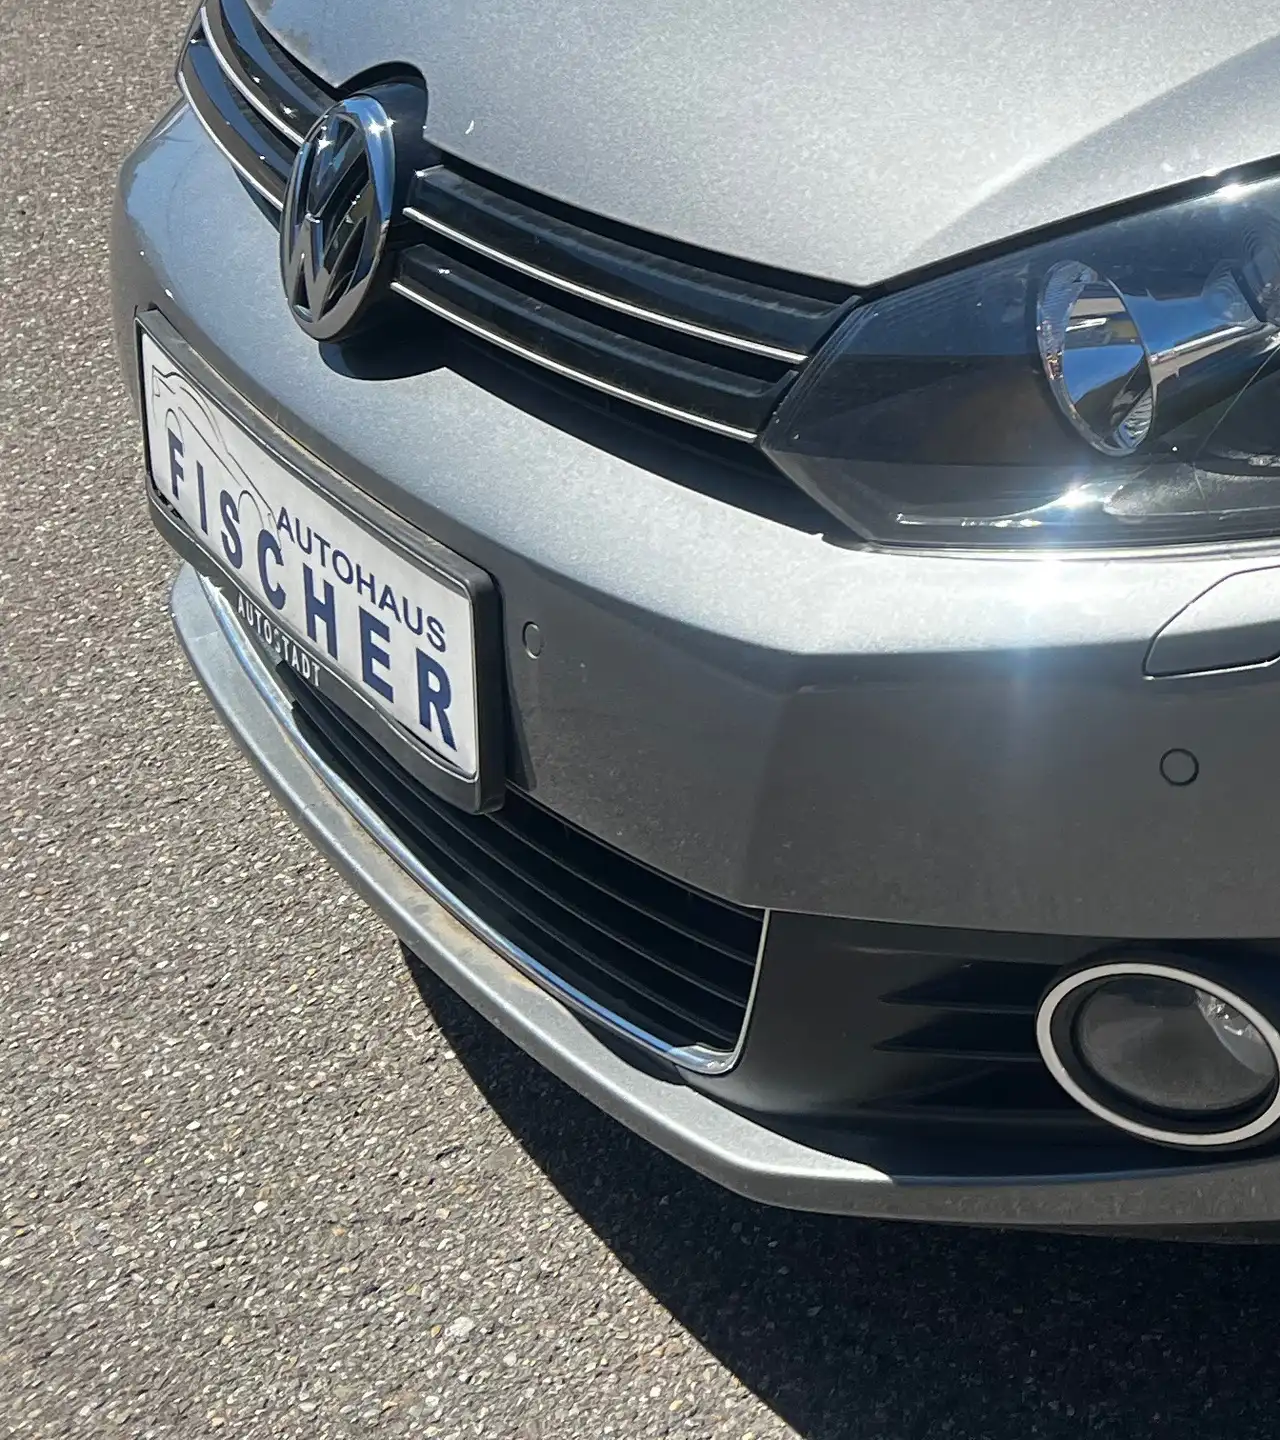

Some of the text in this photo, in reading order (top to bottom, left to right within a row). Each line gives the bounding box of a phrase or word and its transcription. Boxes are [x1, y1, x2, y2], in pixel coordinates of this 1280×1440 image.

[167, 428, 457, 751] FISCHER
[237, 592, 320, 687] AUTOSTADT
[277, 506, 446, 653] AUTOHAUS
